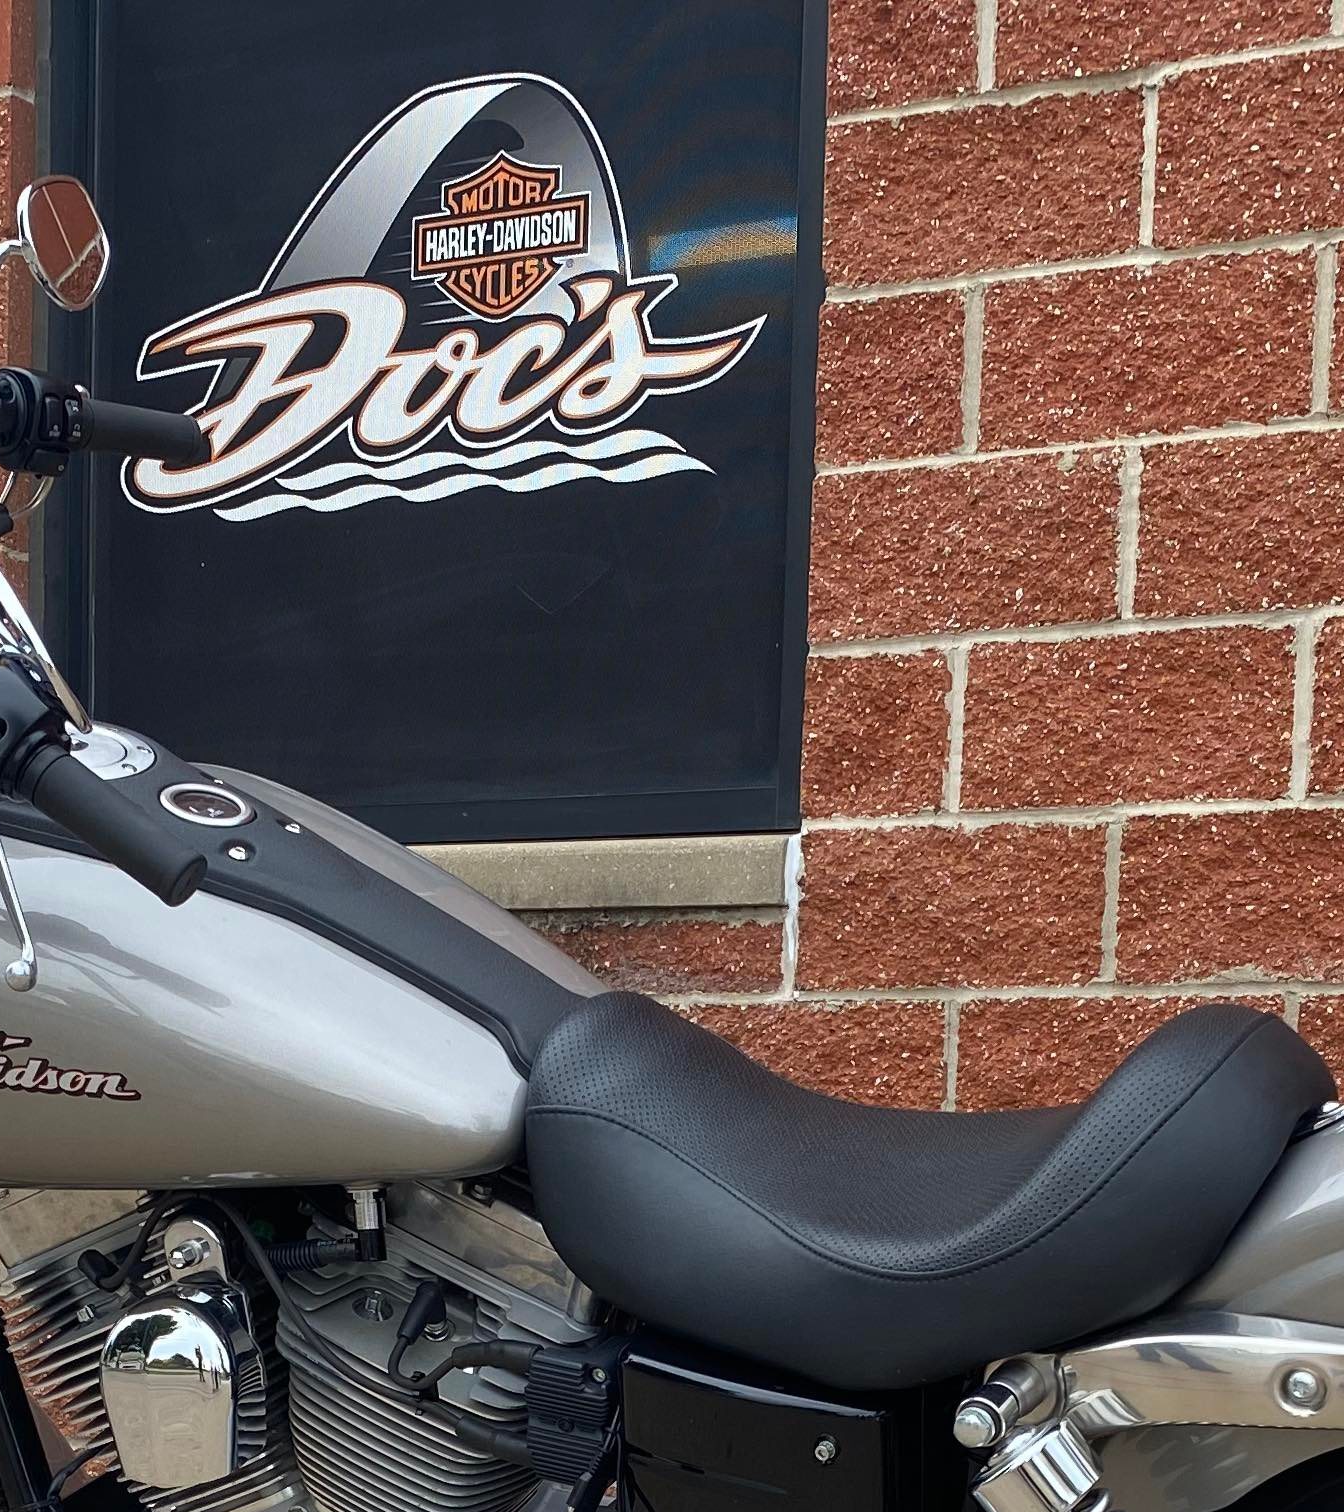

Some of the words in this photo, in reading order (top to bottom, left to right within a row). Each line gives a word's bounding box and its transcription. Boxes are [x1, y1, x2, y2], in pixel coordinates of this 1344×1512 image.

[461, 171, 541, 214] MOTOR
[424, 208, 577, 263] HARLEY-DAVIDSON
[459, 258, 539, 307] CYCLES
[133, 277, 740, 499] Doc's
